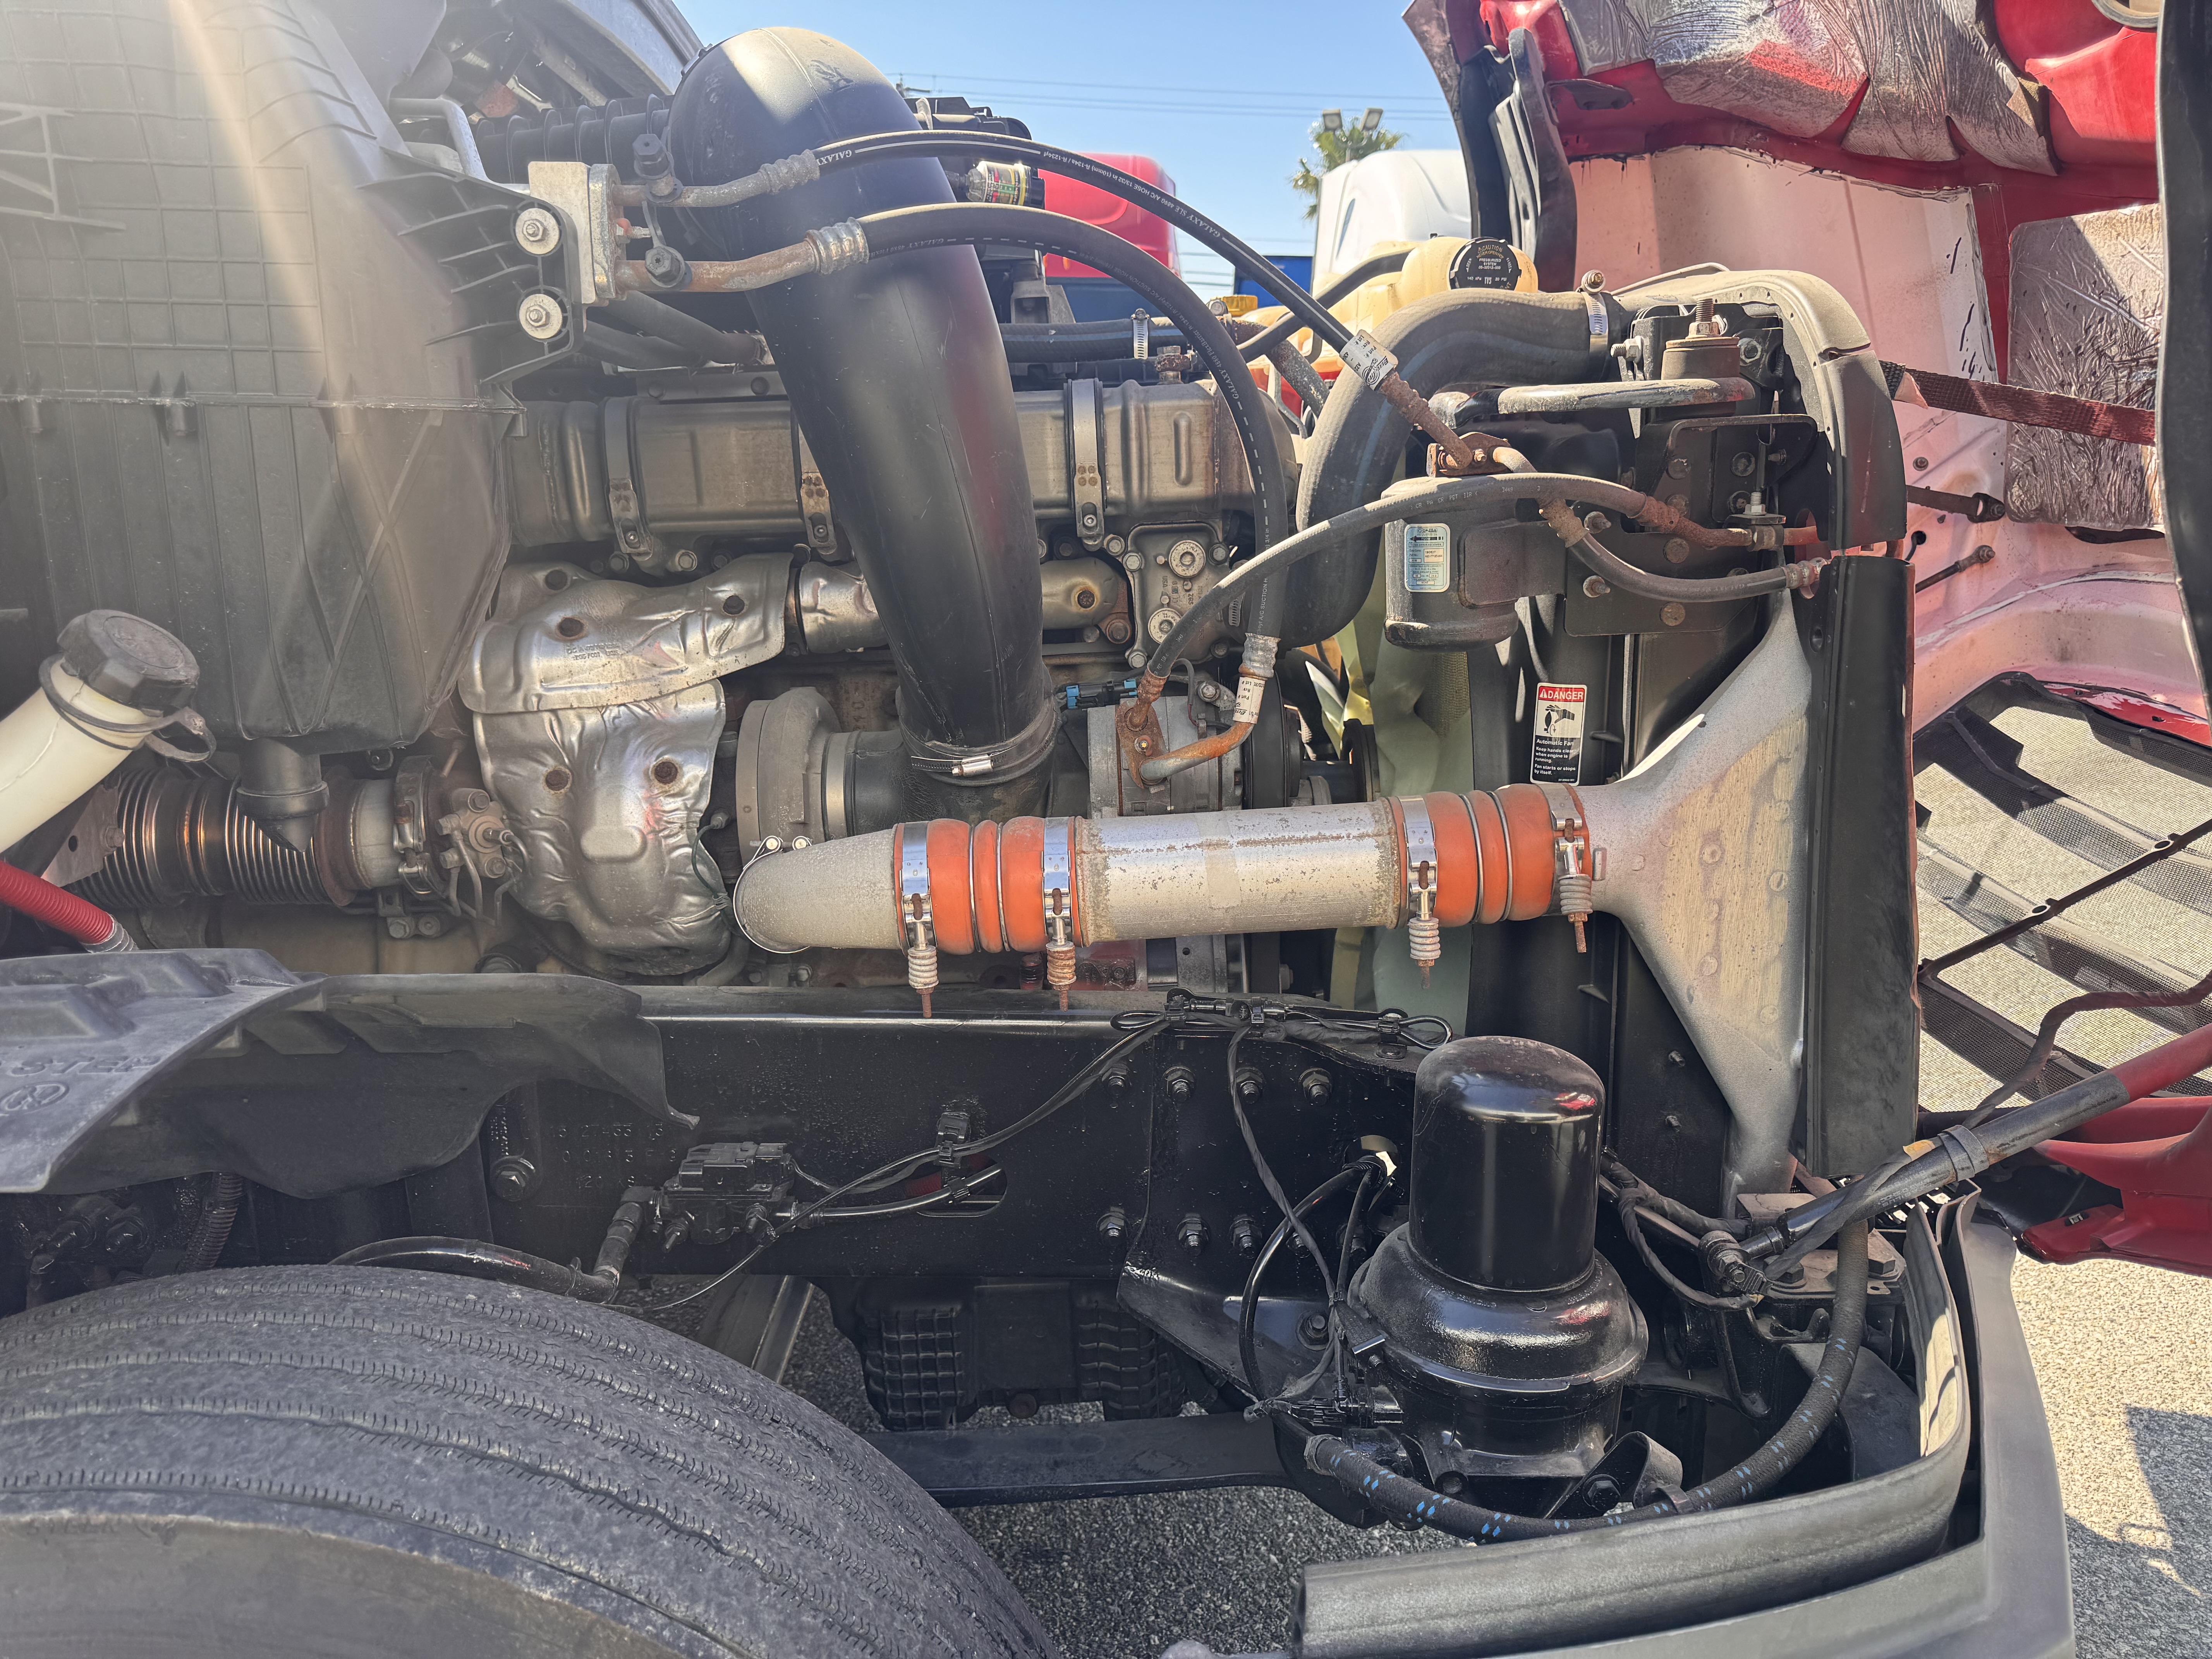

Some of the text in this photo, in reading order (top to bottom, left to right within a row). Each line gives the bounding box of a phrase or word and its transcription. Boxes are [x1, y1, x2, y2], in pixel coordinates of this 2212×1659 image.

[1071, 159, 1091, 170] R-134a
[1091, 165, 1112, 178] (10mm)
[1118, 176, 1133, 187] 13/32
[1133, 184, 1150, 196] HOSE
[1161, 198, 1175, 208] 4890
[1175, 205, 1187, 216] SLE
[1186, 214, 1221, 237] GALAXY
[907, 238, 944, 249] GALAXY
[1368, 345, 1377, 354] Part
[1219, 369, 1239, 399] GALAXY
[1547, 690, 1584, 700] DANGER
[9, 1055, 162, 1077] STEP
